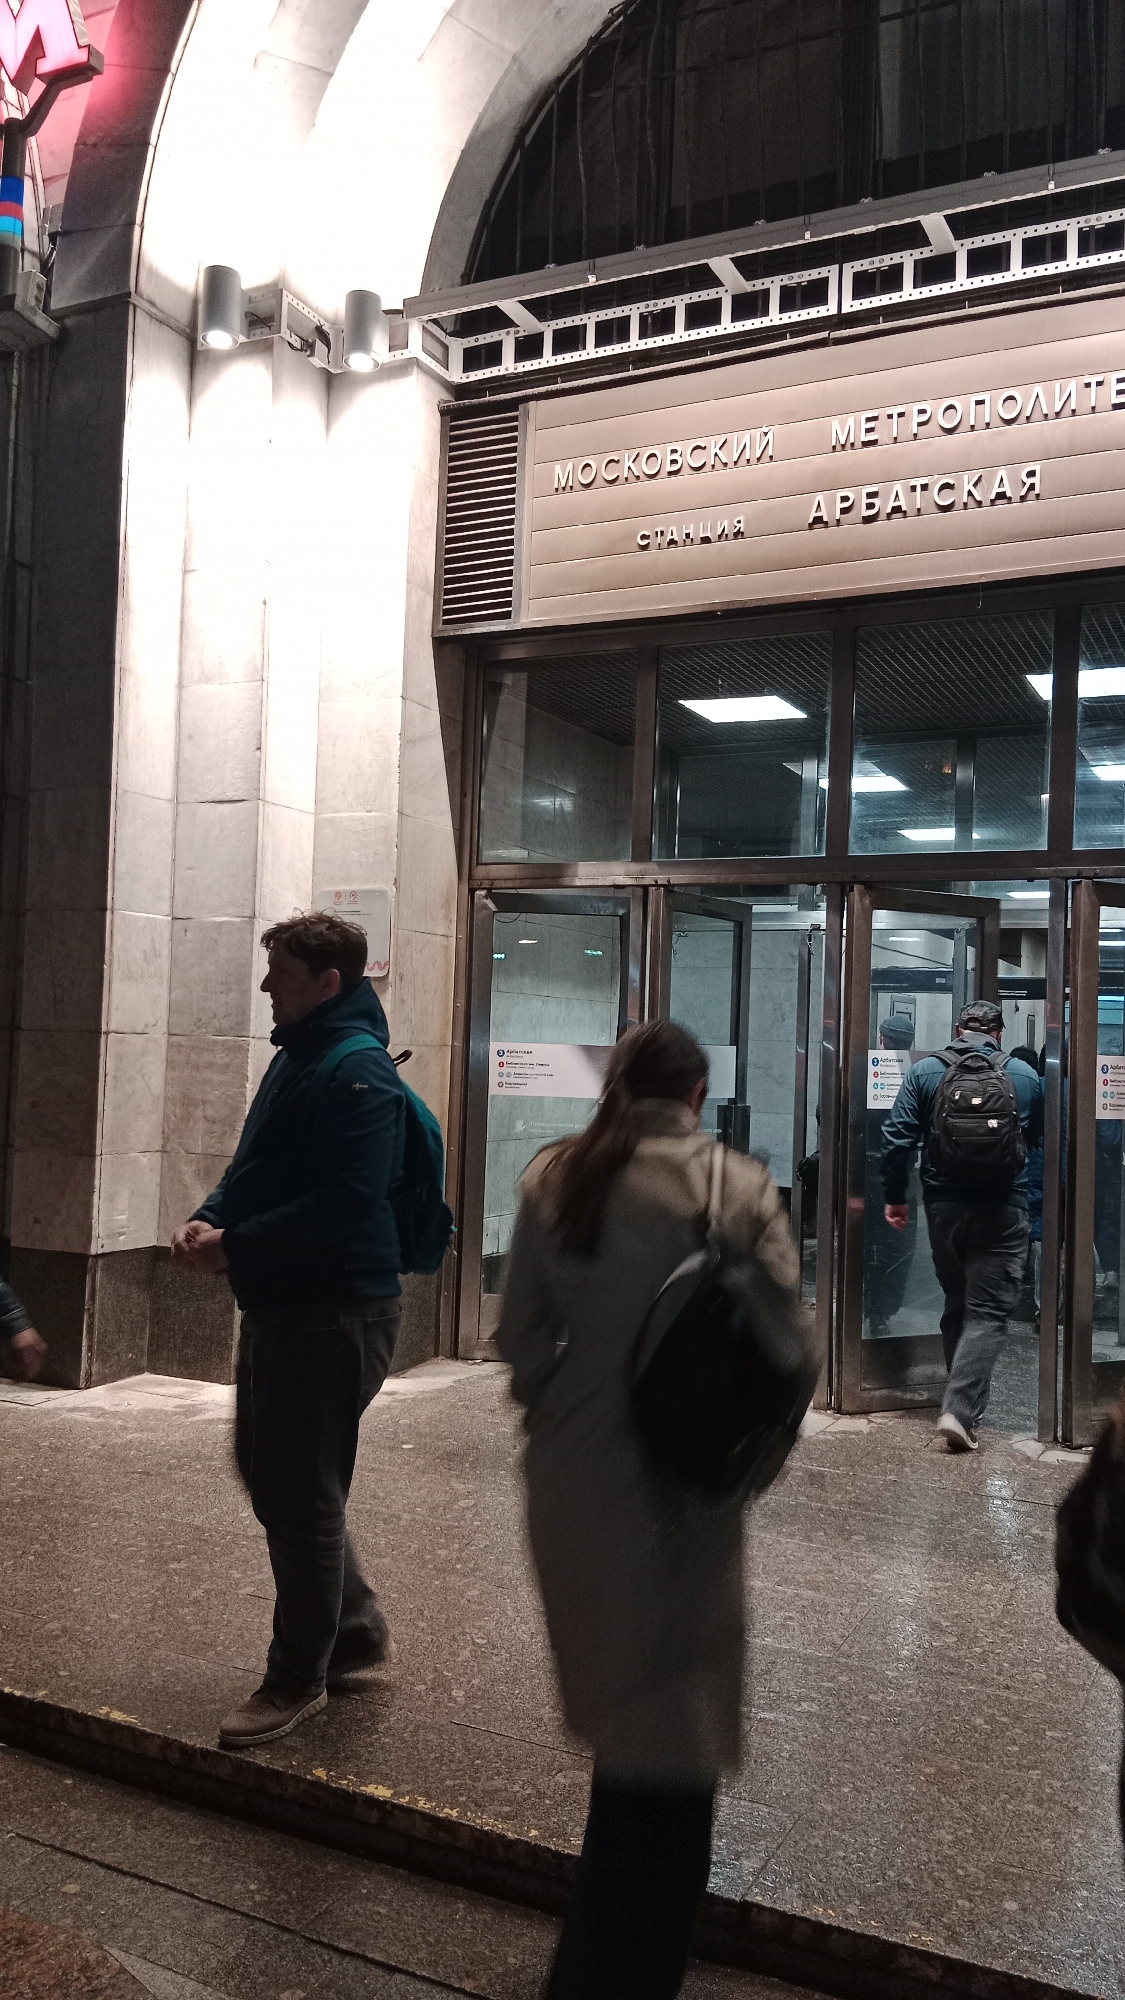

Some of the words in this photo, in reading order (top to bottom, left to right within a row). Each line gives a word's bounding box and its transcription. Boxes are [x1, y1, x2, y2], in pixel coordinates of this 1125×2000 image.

[553, 425, 774, 491] МОСКОВСКИЙ
[831, 374, 1125, 449] МЕТРОПОЛИТЕ
[636, 516, 744, 549] СТАНЦИЯ
[807, 464, 1041, 527] АРБАТСКАЯ
